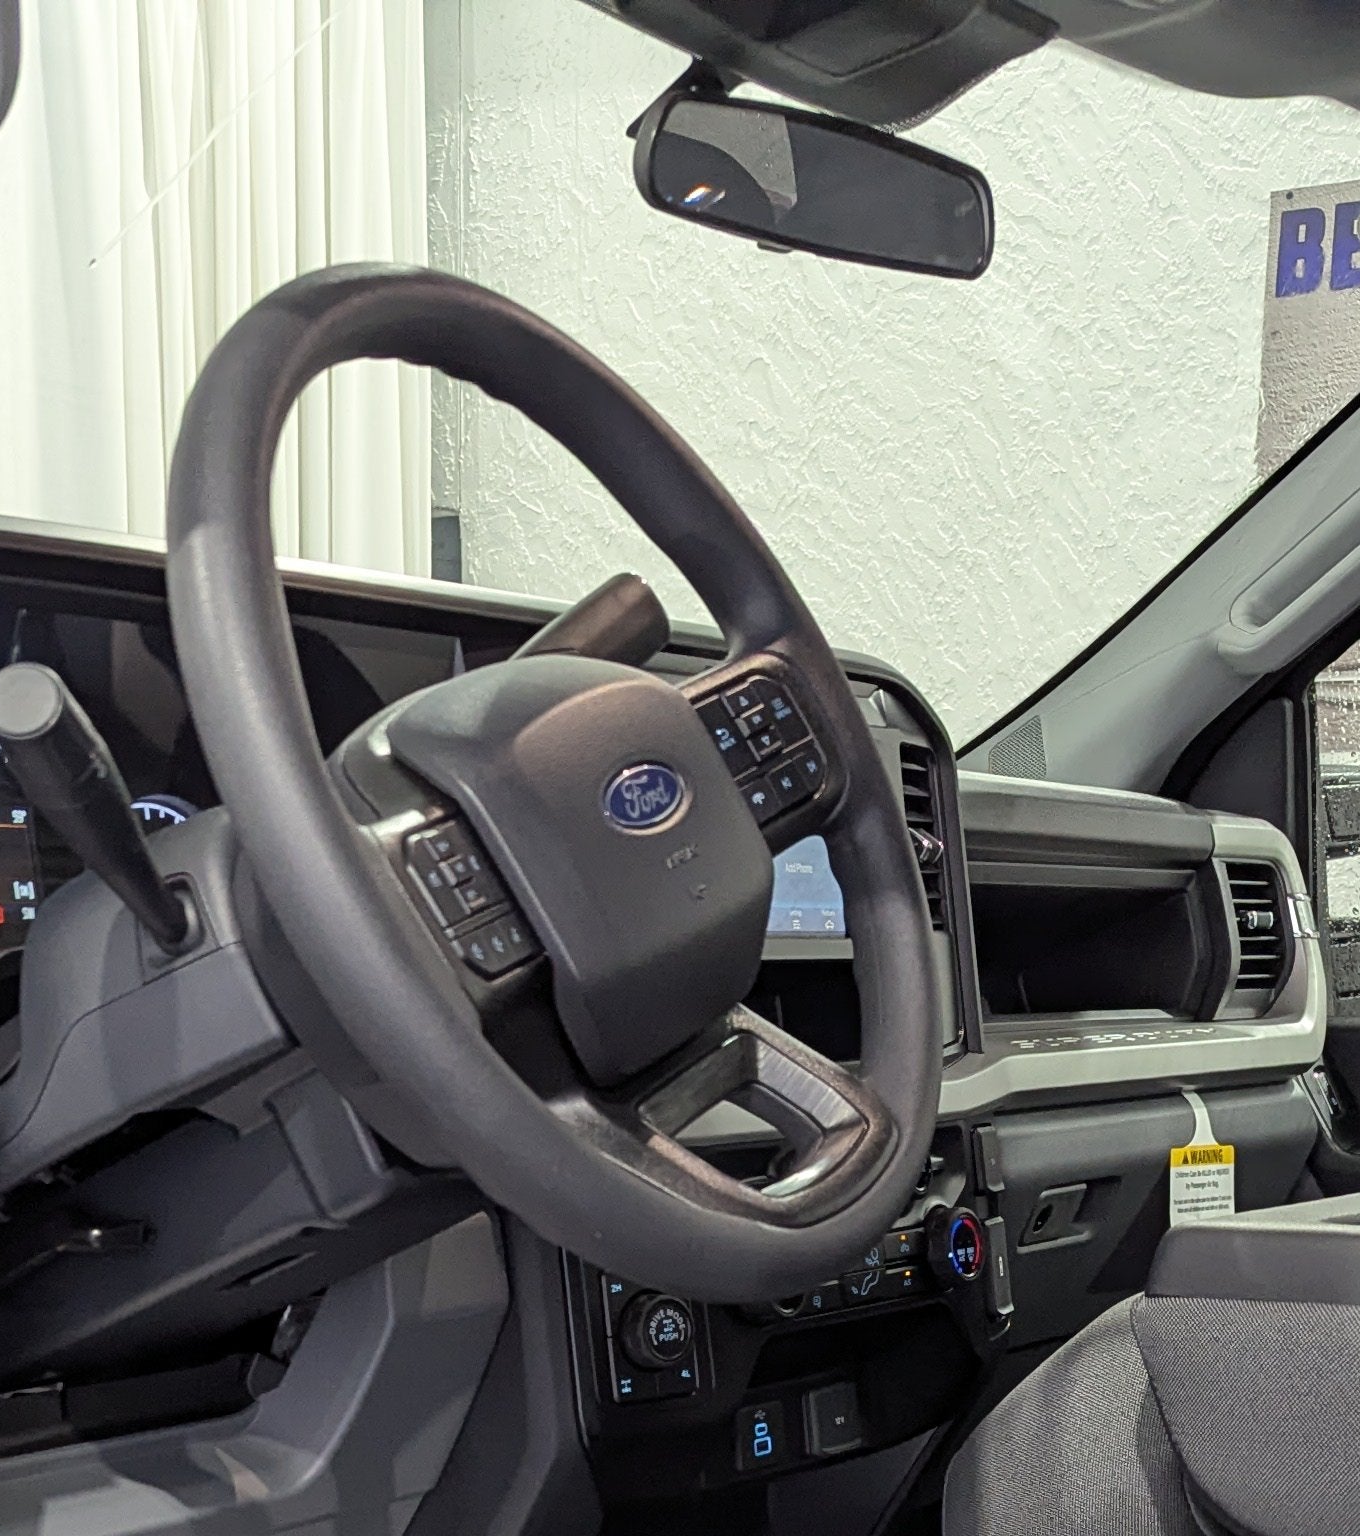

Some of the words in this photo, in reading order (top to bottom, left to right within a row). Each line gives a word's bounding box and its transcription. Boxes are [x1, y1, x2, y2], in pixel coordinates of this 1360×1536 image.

[620, 774, 671, 819] Ford
[1190, 1148, 1224, 1165] WARNING
[648, 1308, 666, 1335] DRIVE
[666, 1308, 686, 1329] MODE
[659, 1331, 679, 1342] PUSH
